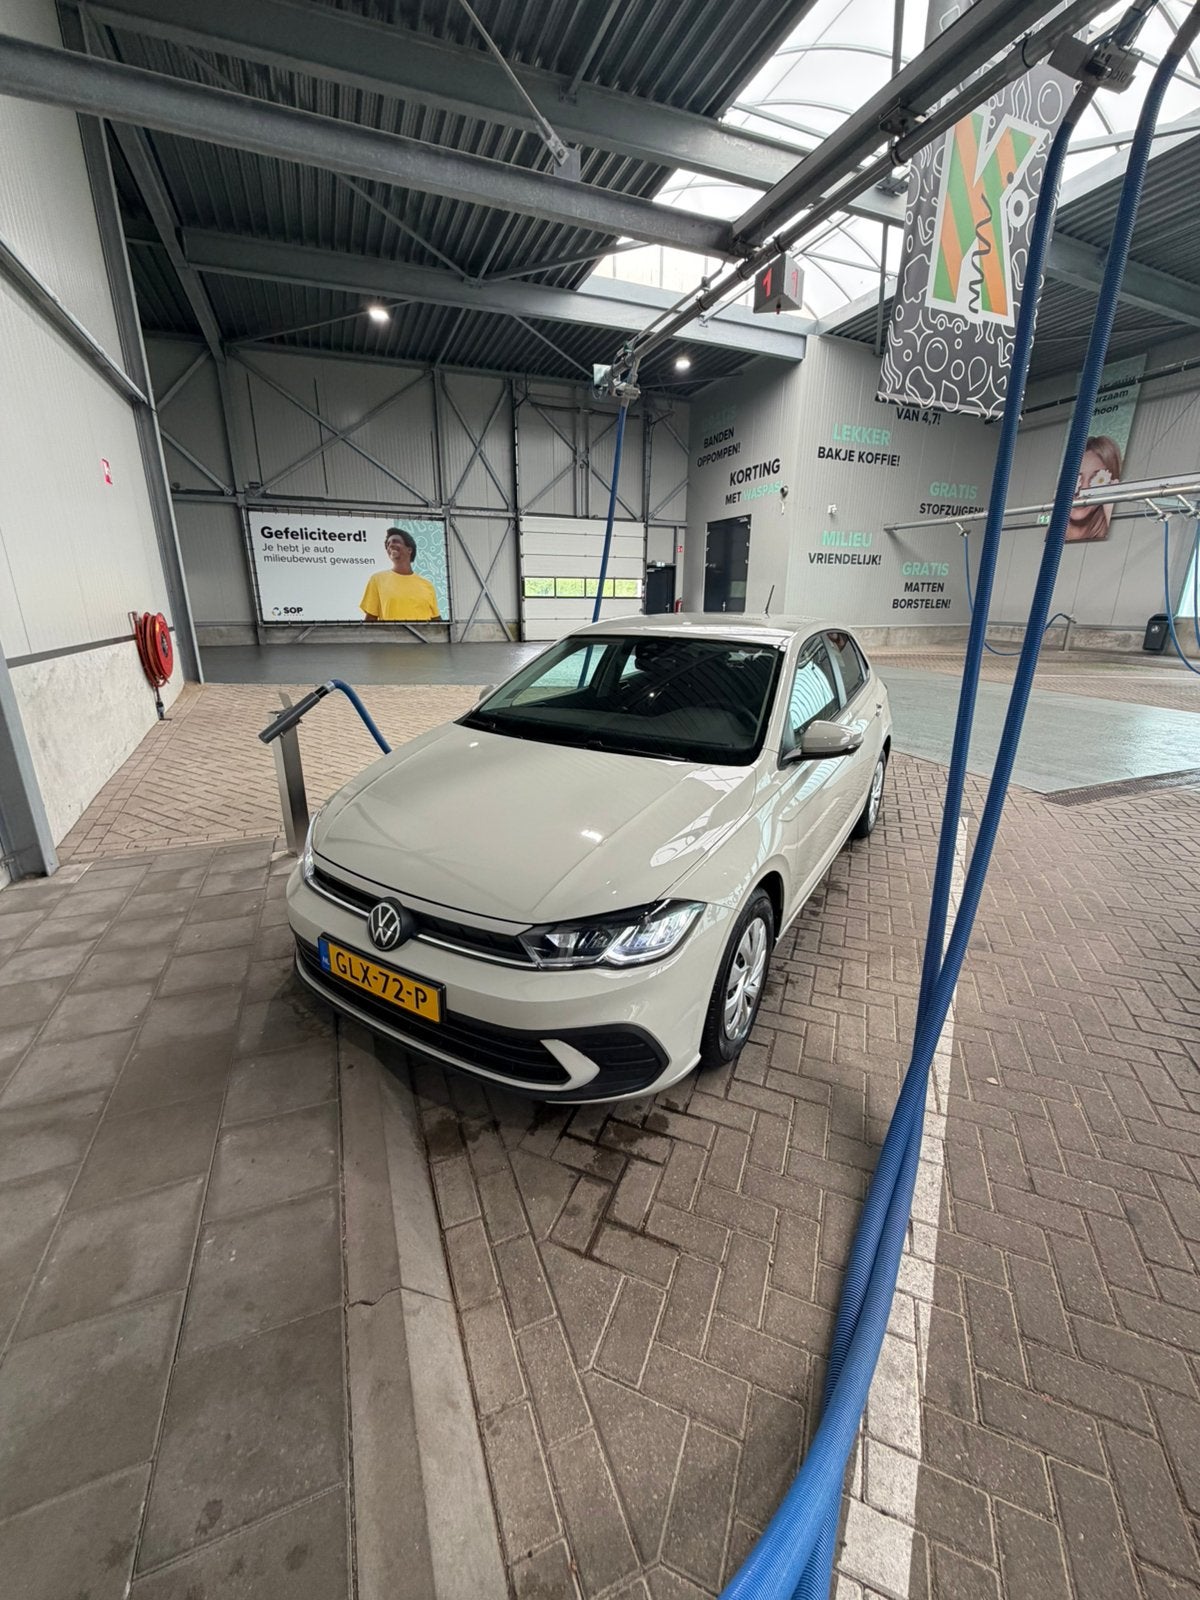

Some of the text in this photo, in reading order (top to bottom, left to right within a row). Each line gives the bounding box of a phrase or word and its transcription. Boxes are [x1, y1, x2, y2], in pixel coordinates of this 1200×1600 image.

[762, 267, 773, 298] 1
[791, 268, 799, 298] 1
[896, 406, 941, 426] VAN 4,7!
[703, 426, 735, 449] BANDEN
[832, 423, 891, 446] LEKKER
[697, 442, 741, 467] OPPOMPEN!
[818, 446, 901, 467] BAKJE KOFFIE!
[729, 457, 781, 487] KORTING
[725, 490, 742, 506] MET
[929, 481, 978, 500] GRATIS
[260, 525, 367, 542] Gefeliciteerd!
[821, 530, 873, 548] MILIEU
[262, 543, 335, 555] Je hebt je auto
[263, 553, 376, 566] milieubewust gewassen
[808, 552, 882, 566] VRIENDELIJK!
[902, 562, 949, 577] GRATIS
[904, 582, 945, 593] MATTEN
[283, 606, 304, 614] SOP
[892, 598, 951, 609] BORSTELEN!
[335, 951, 428, 1010] GLX-72-P
